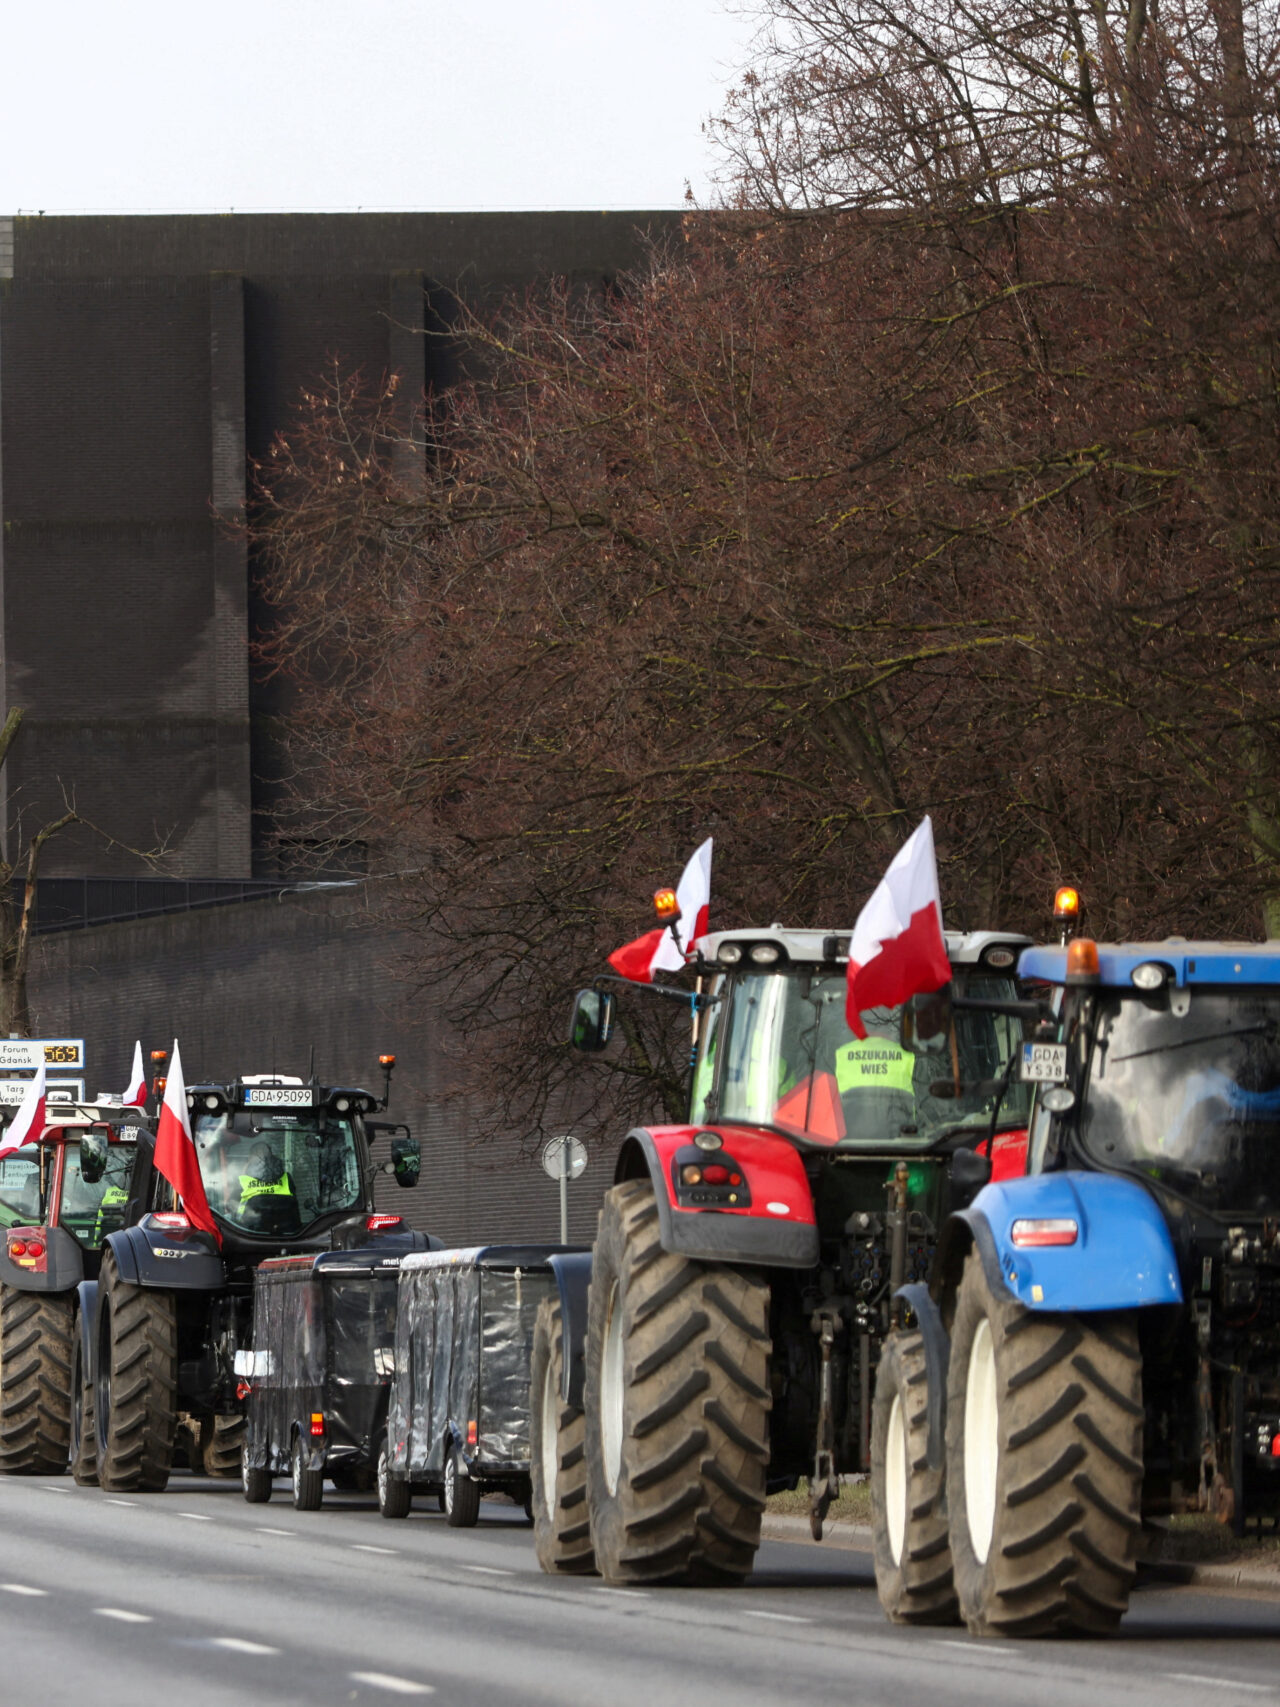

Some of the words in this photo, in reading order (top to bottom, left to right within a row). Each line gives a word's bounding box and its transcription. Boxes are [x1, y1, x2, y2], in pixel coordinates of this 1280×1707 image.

[2, 1045, 29, 1053] Forum
[44, 1046, 76, 1062] 569
[847, 1050, 903, 1061] OSZUKANA
[861, 1062, 889, 1074] WIEŚ
[6, 1085, 24, 1094] Targ
[251, 1090, 273, 1102] GDA
[277, 1091, 311, 1103] 95099
